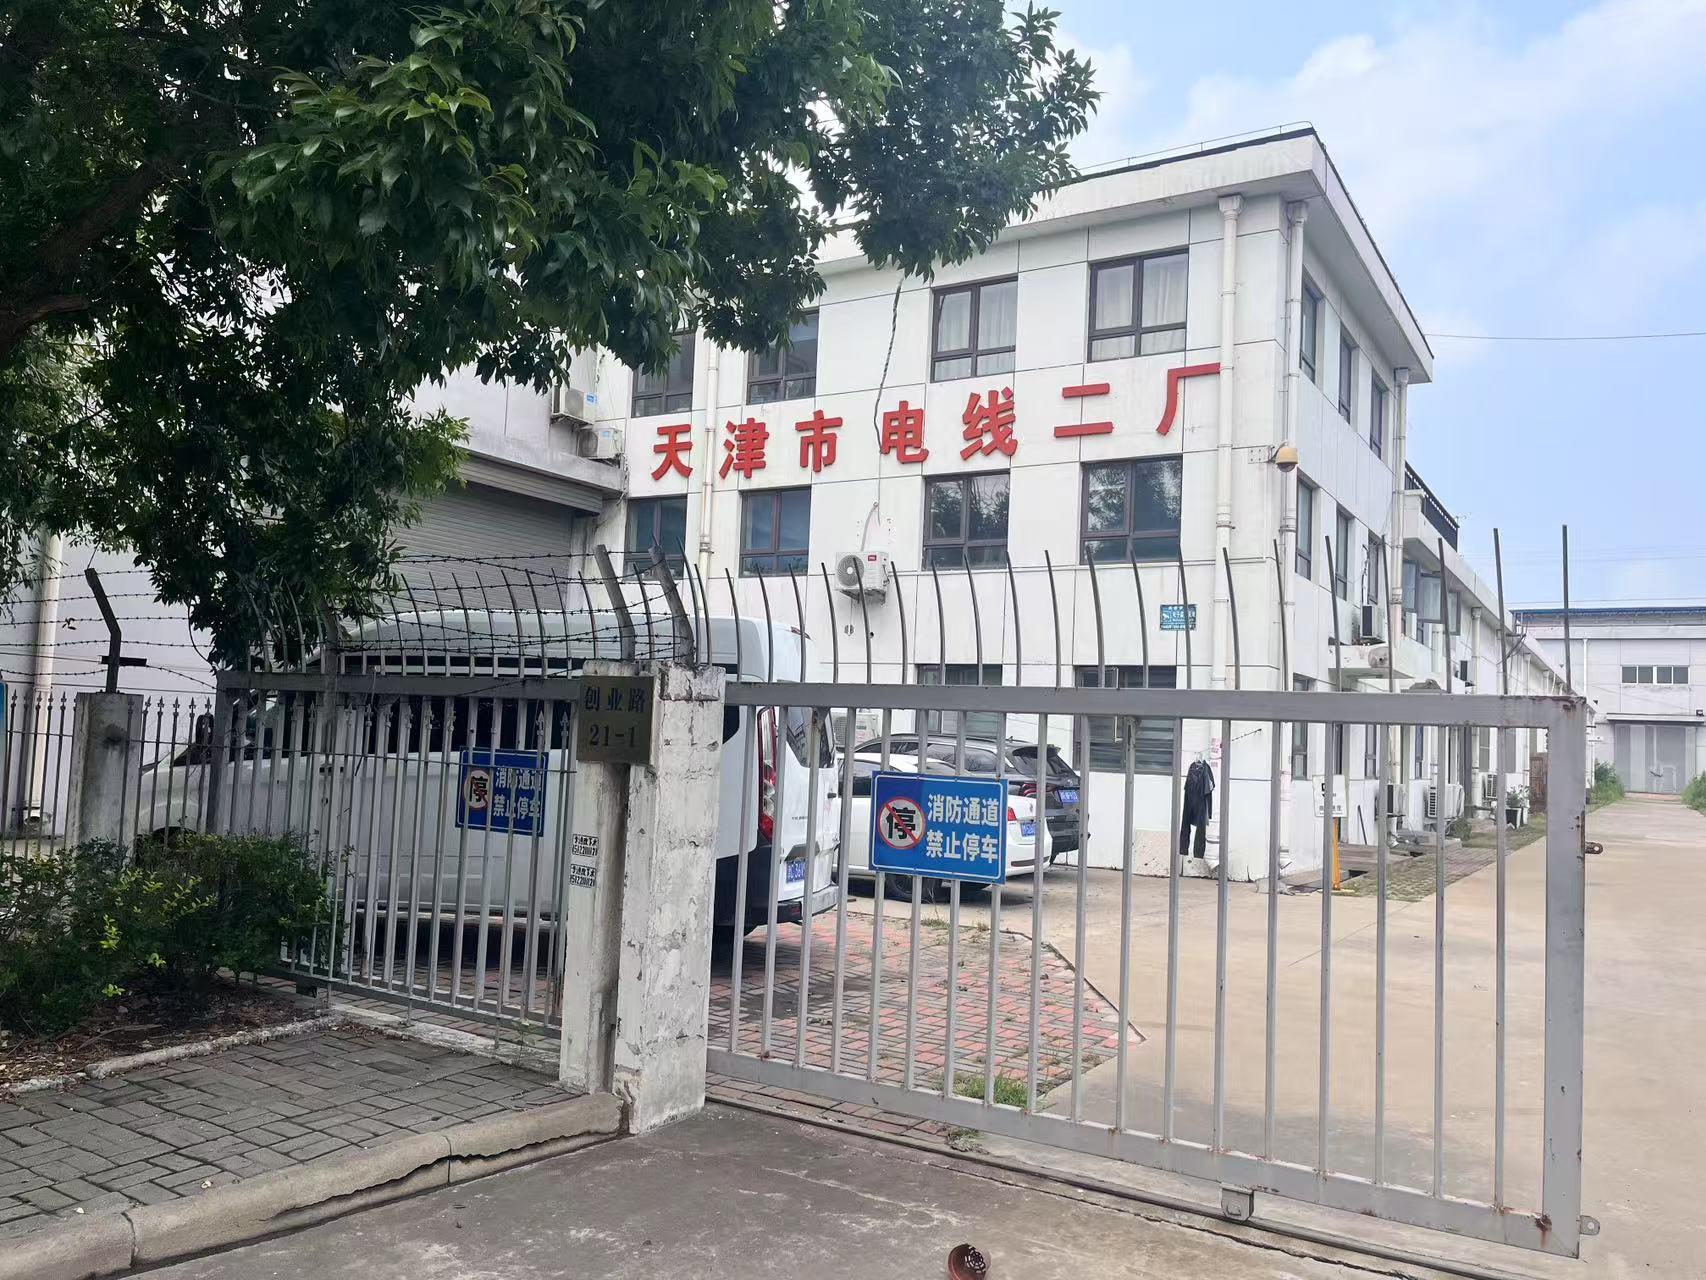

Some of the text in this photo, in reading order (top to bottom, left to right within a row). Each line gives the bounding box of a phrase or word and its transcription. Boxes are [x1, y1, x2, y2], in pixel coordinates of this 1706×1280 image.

[651, 362, 1221, 481] 天津市电线二厂
[585, 686, 646, 713] 创业路
[589, 723, 636, 748] 21-1
[885, 806, 916, 840] 停
[927, 793, 1000, 827] 消防通道
[925, 829, 999, 864] 禁止停车
